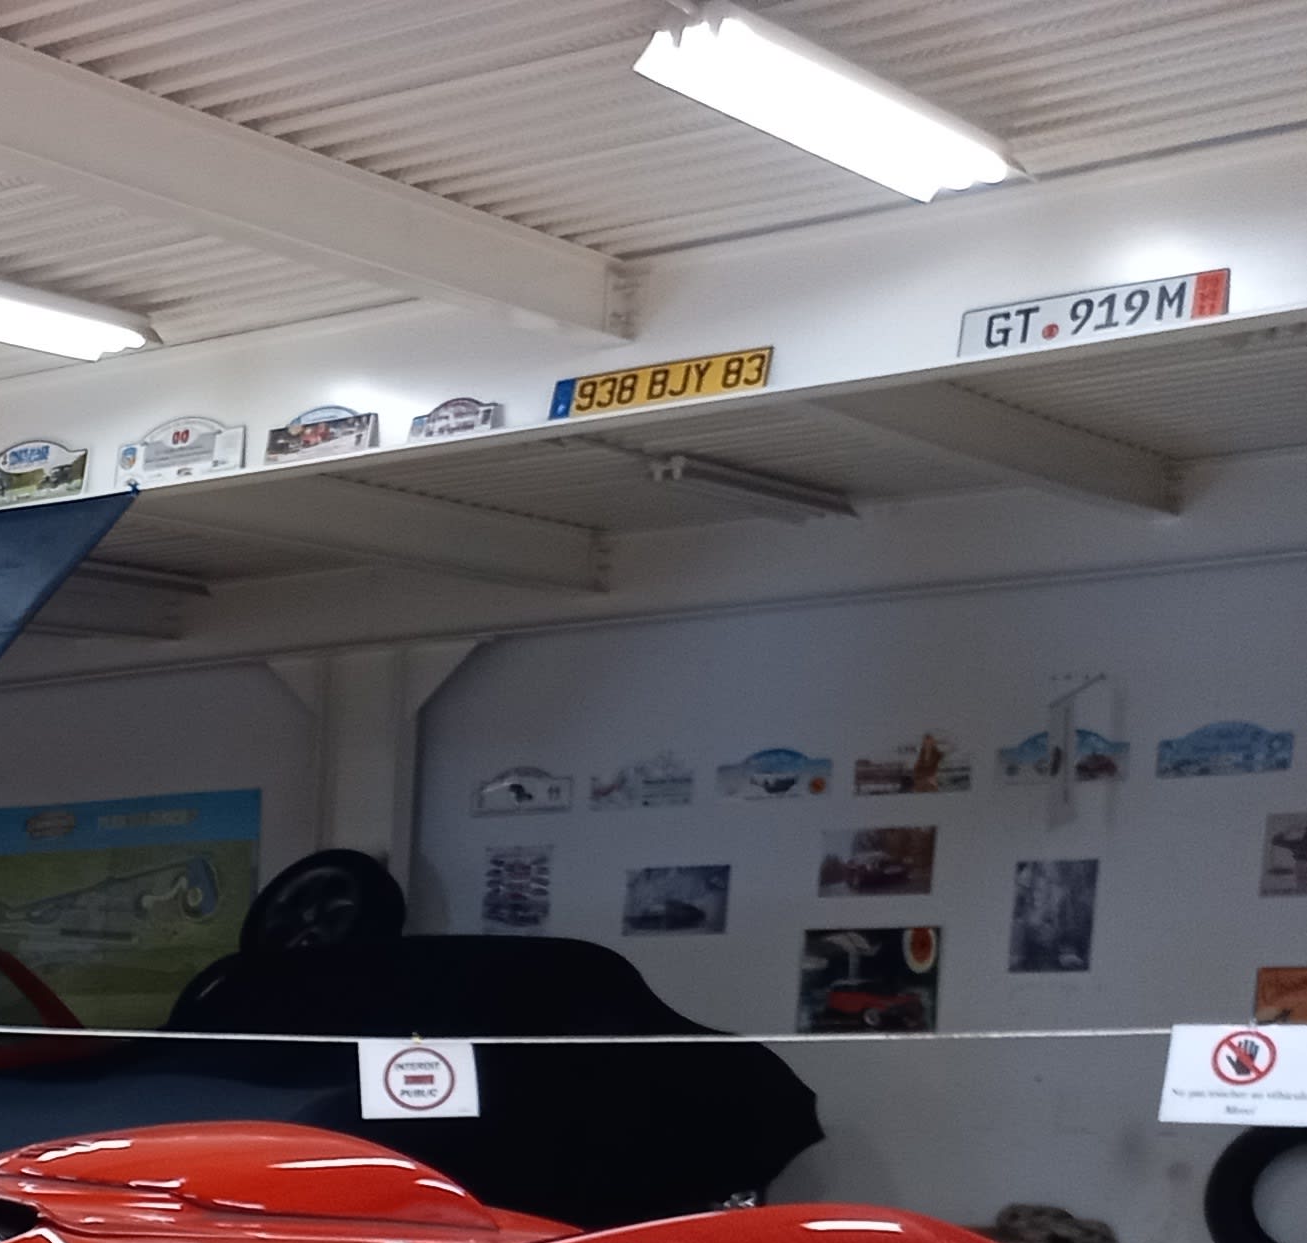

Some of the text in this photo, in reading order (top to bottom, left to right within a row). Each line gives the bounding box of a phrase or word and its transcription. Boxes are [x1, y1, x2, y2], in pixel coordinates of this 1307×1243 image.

[985, 306, 1040, 350] GT
[574, 352, 767, 412] 938 BJY 83
[394, 1061, 441, 1071] INTERDIT
[400, 1088, 438, 1098] PUBLIC
